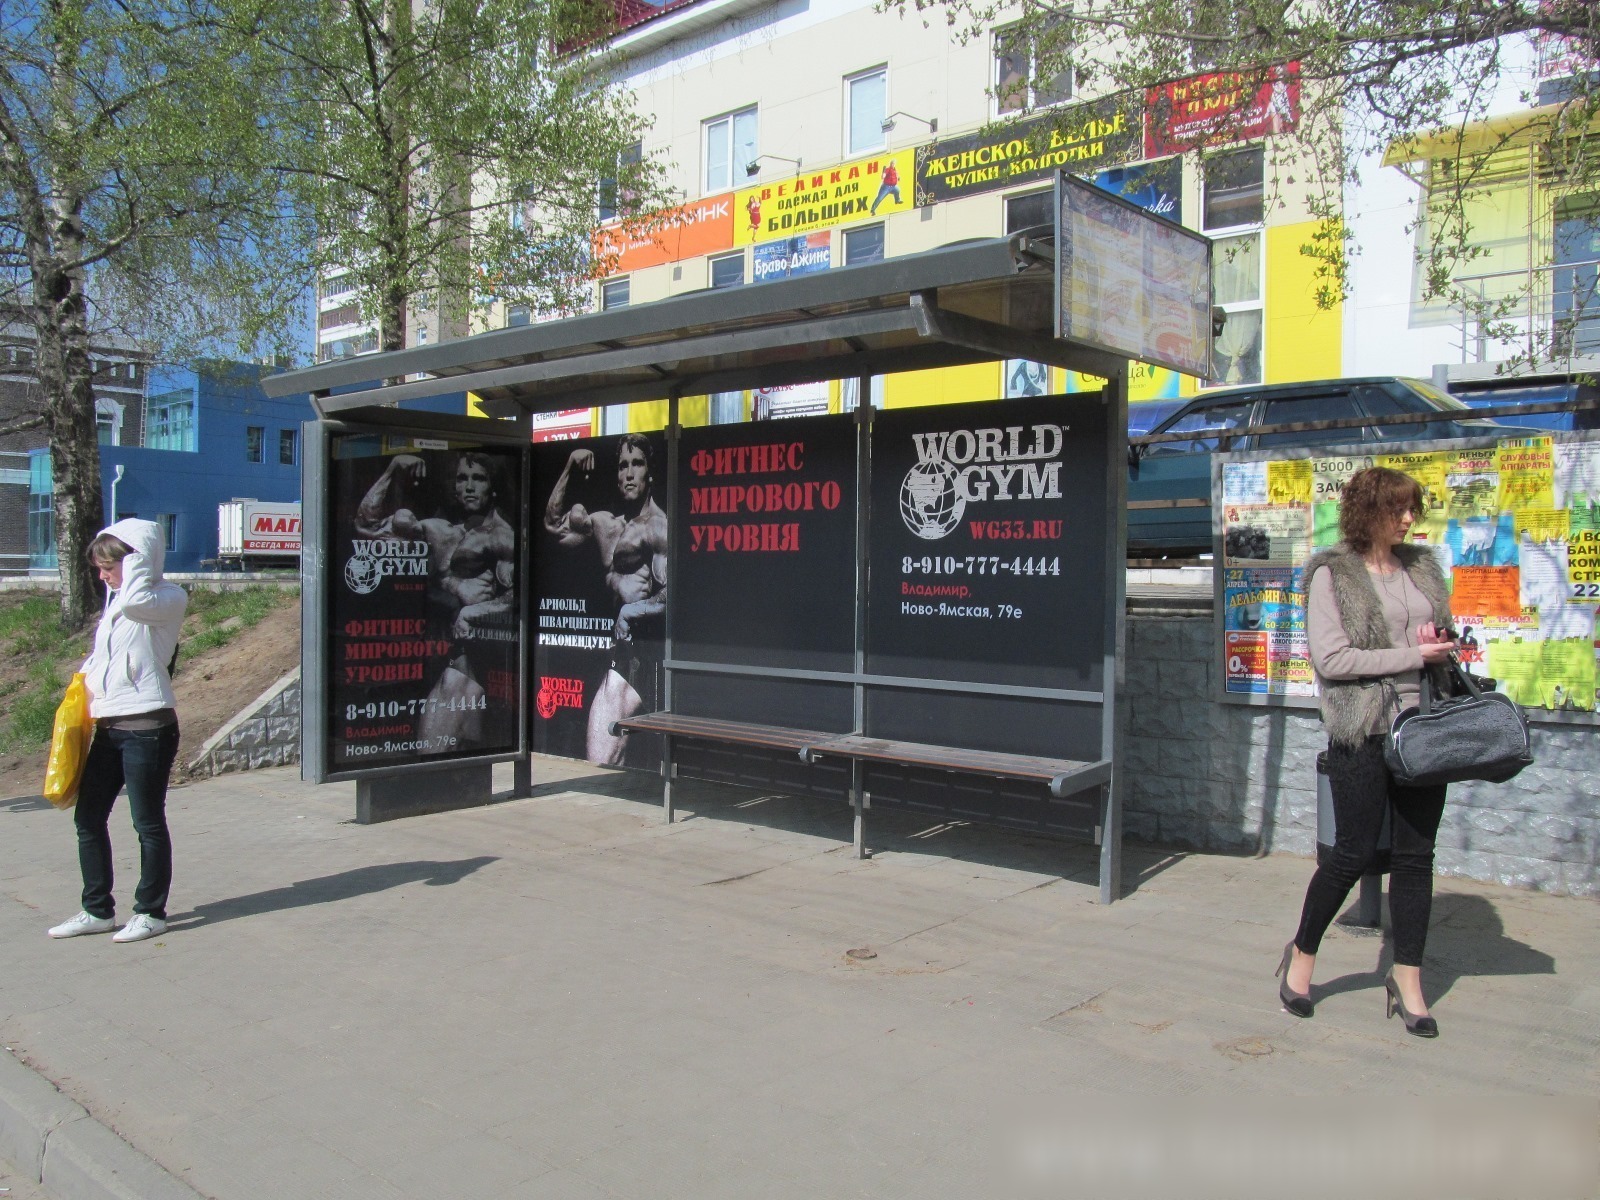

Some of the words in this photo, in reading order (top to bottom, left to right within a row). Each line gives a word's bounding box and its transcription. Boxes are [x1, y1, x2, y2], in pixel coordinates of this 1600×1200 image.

[761, 161, 879, 201] ВЕЛИКАН
[945, 164, 1000, 189] ЧУЛКИ
[768, 196, 869, 232] БОЛЬШИХ
[755, 259, 788, 279] Браво
[790, 250, 830, 269] Джинс
[911, 424, 1063, 464] WORLD
[690, 442, 804, 476] ФИТНЕС
[1388, 455, 1433, 464] РАБОТА!
[1459, 450, 1496, 460] ДЕНЬГИ
[1500, 452, 1550, 462] СЛУХОВЫЕ
[1313, 461, 1353, 473] 15000
[1500, 461, 1551, 471] АППАРАТЫ
[959, 462, 1063, 502] GYM
[690, 480, 841, 514] МИРОВОГО
[690, 523, 800, 552] УРОВНЯ
[969, 519, 1063, 540] WG33.RU
[249, 541, 281, 550] ВСЕГДА
[352, 539, 429, 559] WORLD
[1567, 545, 1600, 555] БАН
[379, 557, 429, 577] GYM
[901, 556, 1060, 576] 8-910-777-4444
[1230, 570, 1244, 580] 27
[901, 582, 972, 599] Владимир,
[1230, 588, 1306, 608] ДЕЛЬФИНАРИ
[539, 598, 586, 613] АРНОЛЬД
[901, 602, 993, 619] Ново-Ямская,
[997, 605, 1023, 619] 79е
[345, 619, 427, 638] ФИТНЕС
[539, 615, 614, 631] ШВАРЦНЕГГЕР
[1265, 621, 1305, 629] 60-22-70
[1462, 617, 1484, 625] МАЯ
[345, 640, 449, 661] МИРОВОГО
[538, 633, 612, 650] РЕКОМЕНДУЕТ
[345, 663, 424, 683] УРОВНЯ
[540, 676, 583, 693] WORLD
[345, 694, 487, 721] 8-910-777-4444
[553, 693, 583, 709] GYM
[345, 723, 414, 739] Владимир,
[345, 738, 434, 757] Ново-Ямская,
[435, 734, 458, 749] 79е
